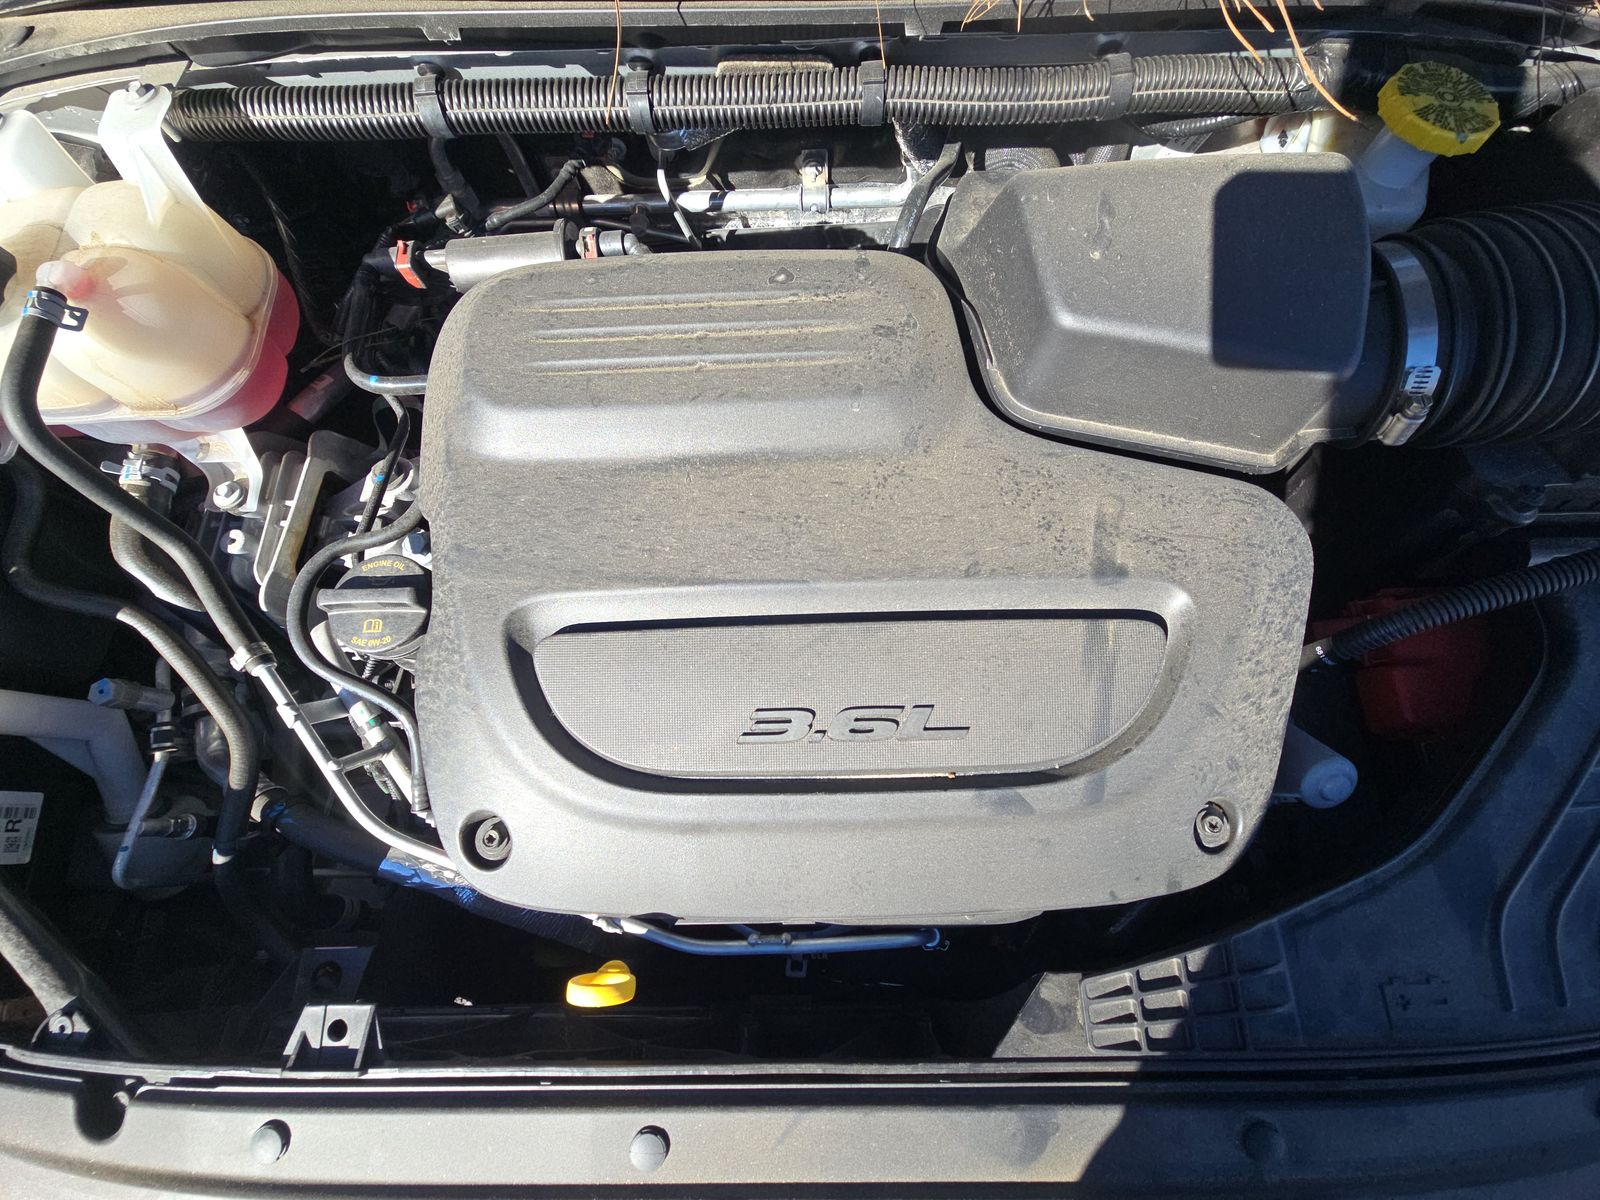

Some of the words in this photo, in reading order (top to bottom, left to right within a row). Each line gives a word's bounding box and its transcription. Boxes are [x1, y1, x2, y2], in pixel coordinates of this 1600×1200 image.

[361, 559, 393, 572] ENGINE
[393, 561, 405, 571] OIL
[351, 636, 368, 647] SAE
[737, 704, 971, 745] 3.6L
